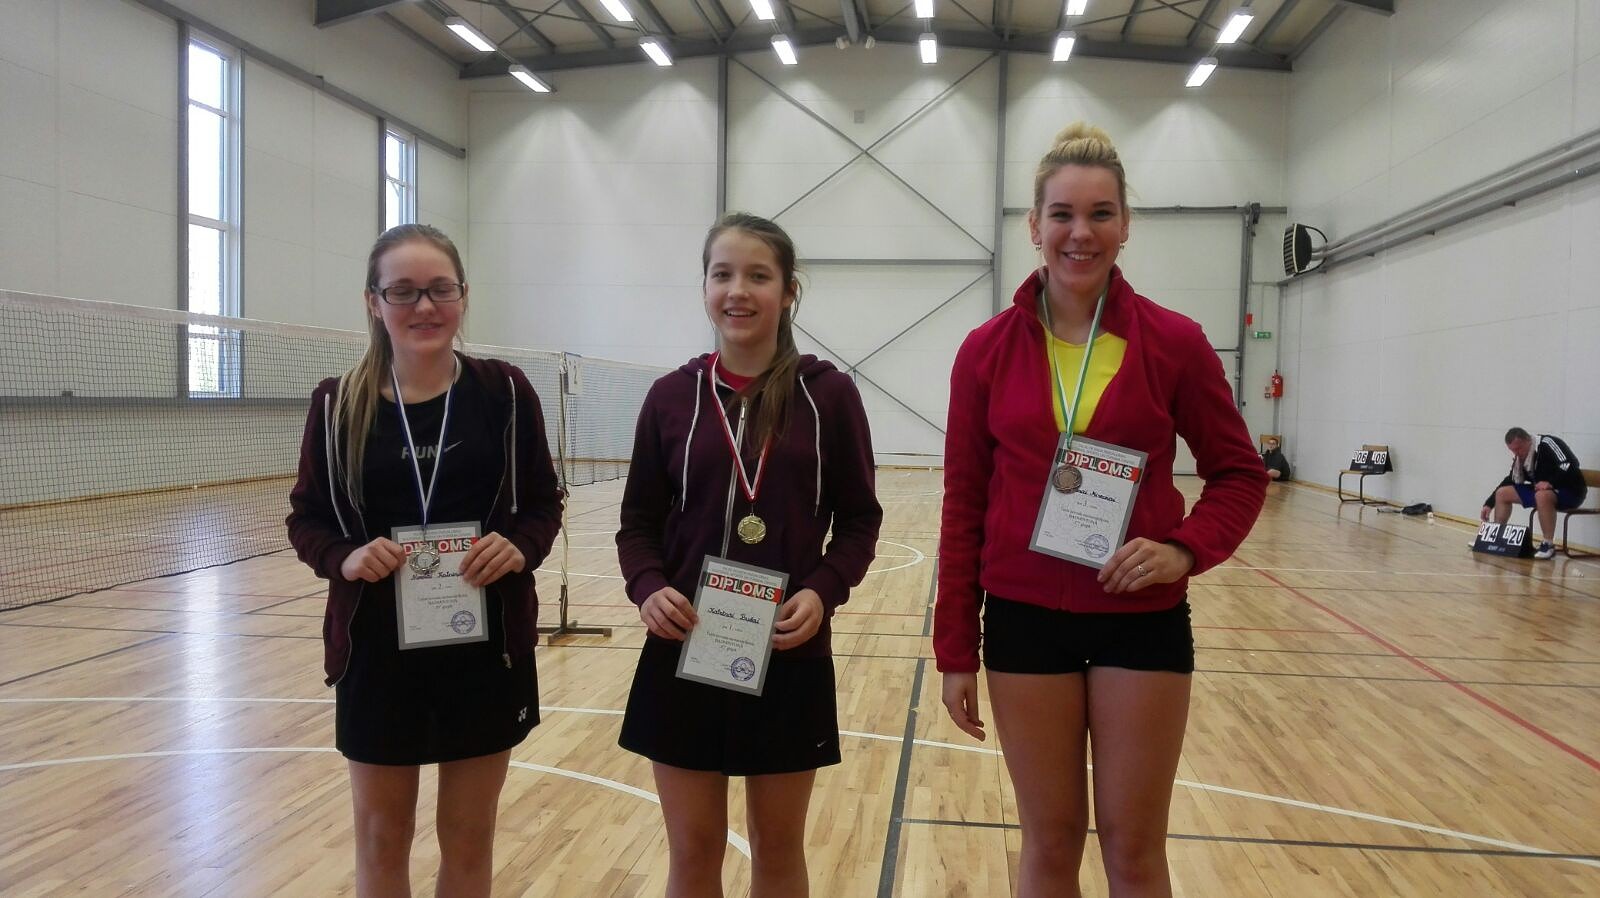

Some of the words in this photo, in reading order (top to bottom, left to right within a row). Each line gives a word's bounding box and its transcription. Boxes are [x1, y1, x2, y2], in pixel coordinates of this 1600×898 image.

[1064, 452, 1133, 479] DIPLOMS
[1356, 452, 1368, 463] 06
[1375, 453, 1386, 464] 08
[1483, 525, 1499, 541] 14
[1508, 529, 1524, 545] 20
[708, 574, 775, 600] DIPLOMS
